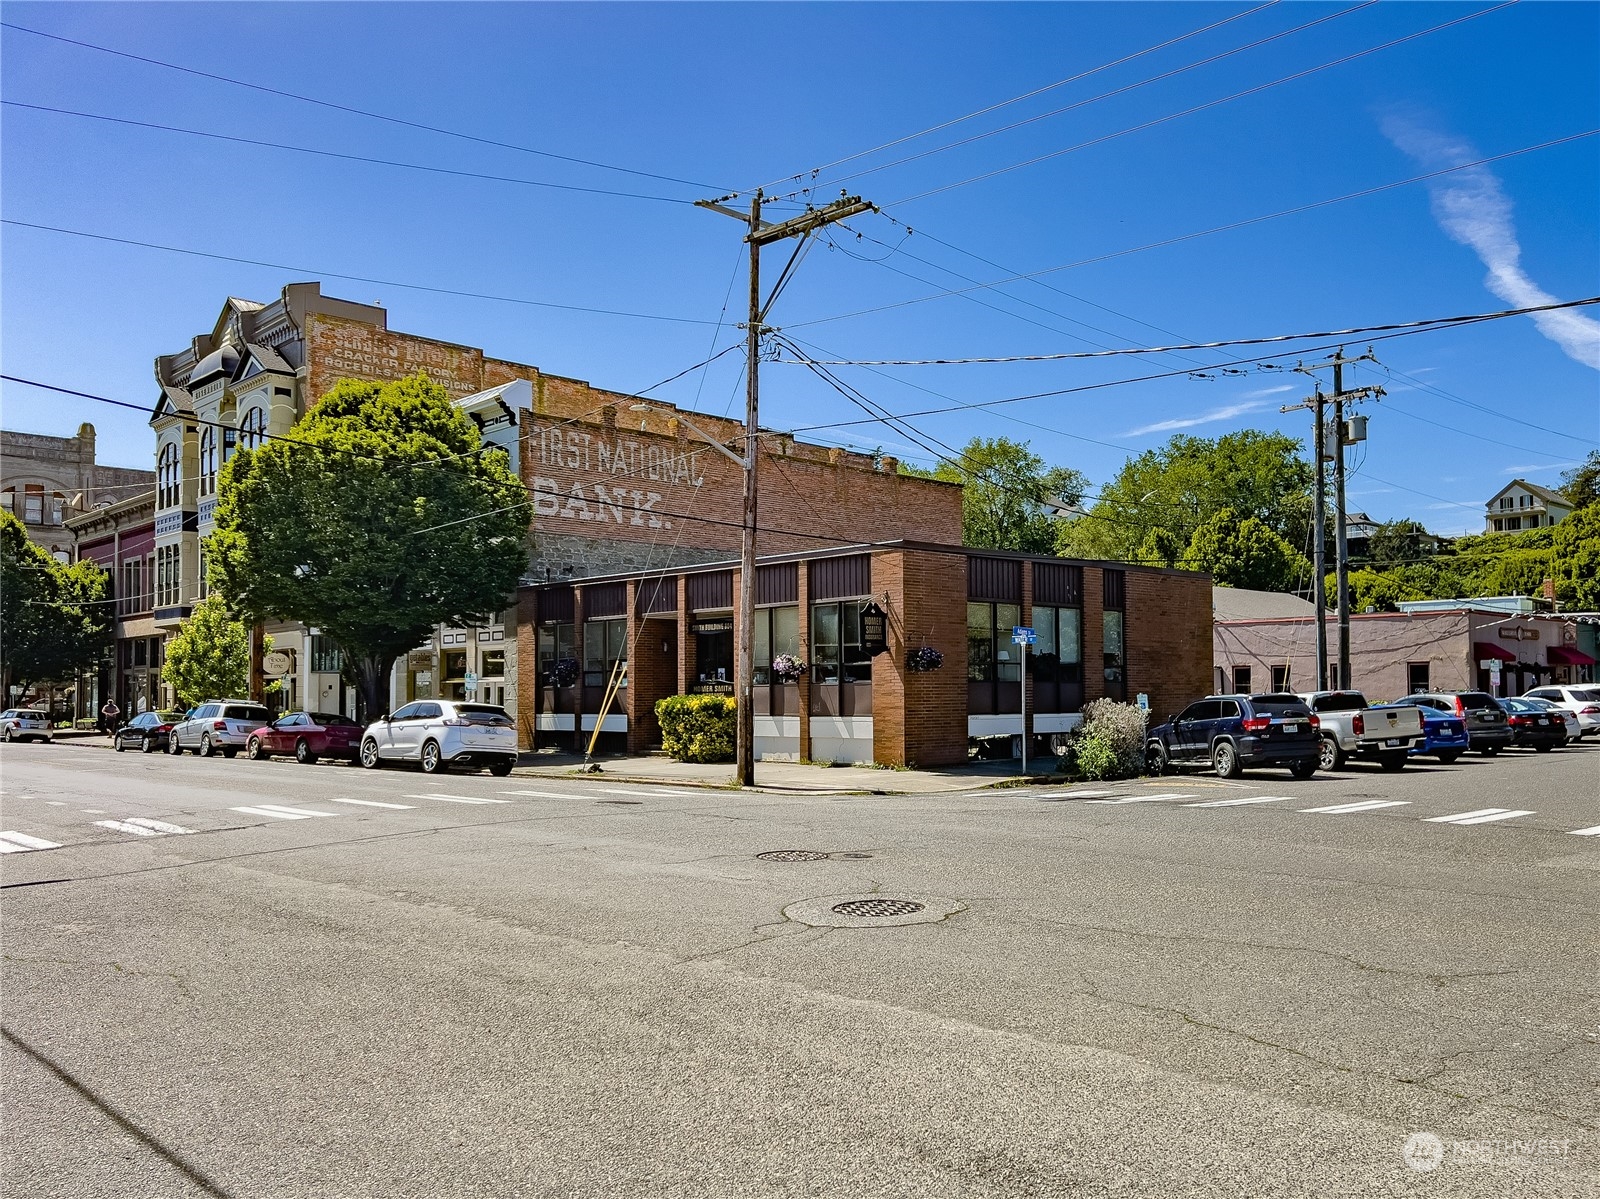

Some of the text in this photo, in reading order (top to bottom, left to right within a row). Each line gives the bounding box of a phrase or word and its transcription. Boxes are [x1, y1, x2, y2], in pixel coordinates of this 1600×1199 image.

[334, 349, 398, 368] CRACKER
[528, 426, 705, 487] FIRST NATIONAL
[864, 616, 882, 625] HOMER
[865, 625, 882, 634] SMITH
